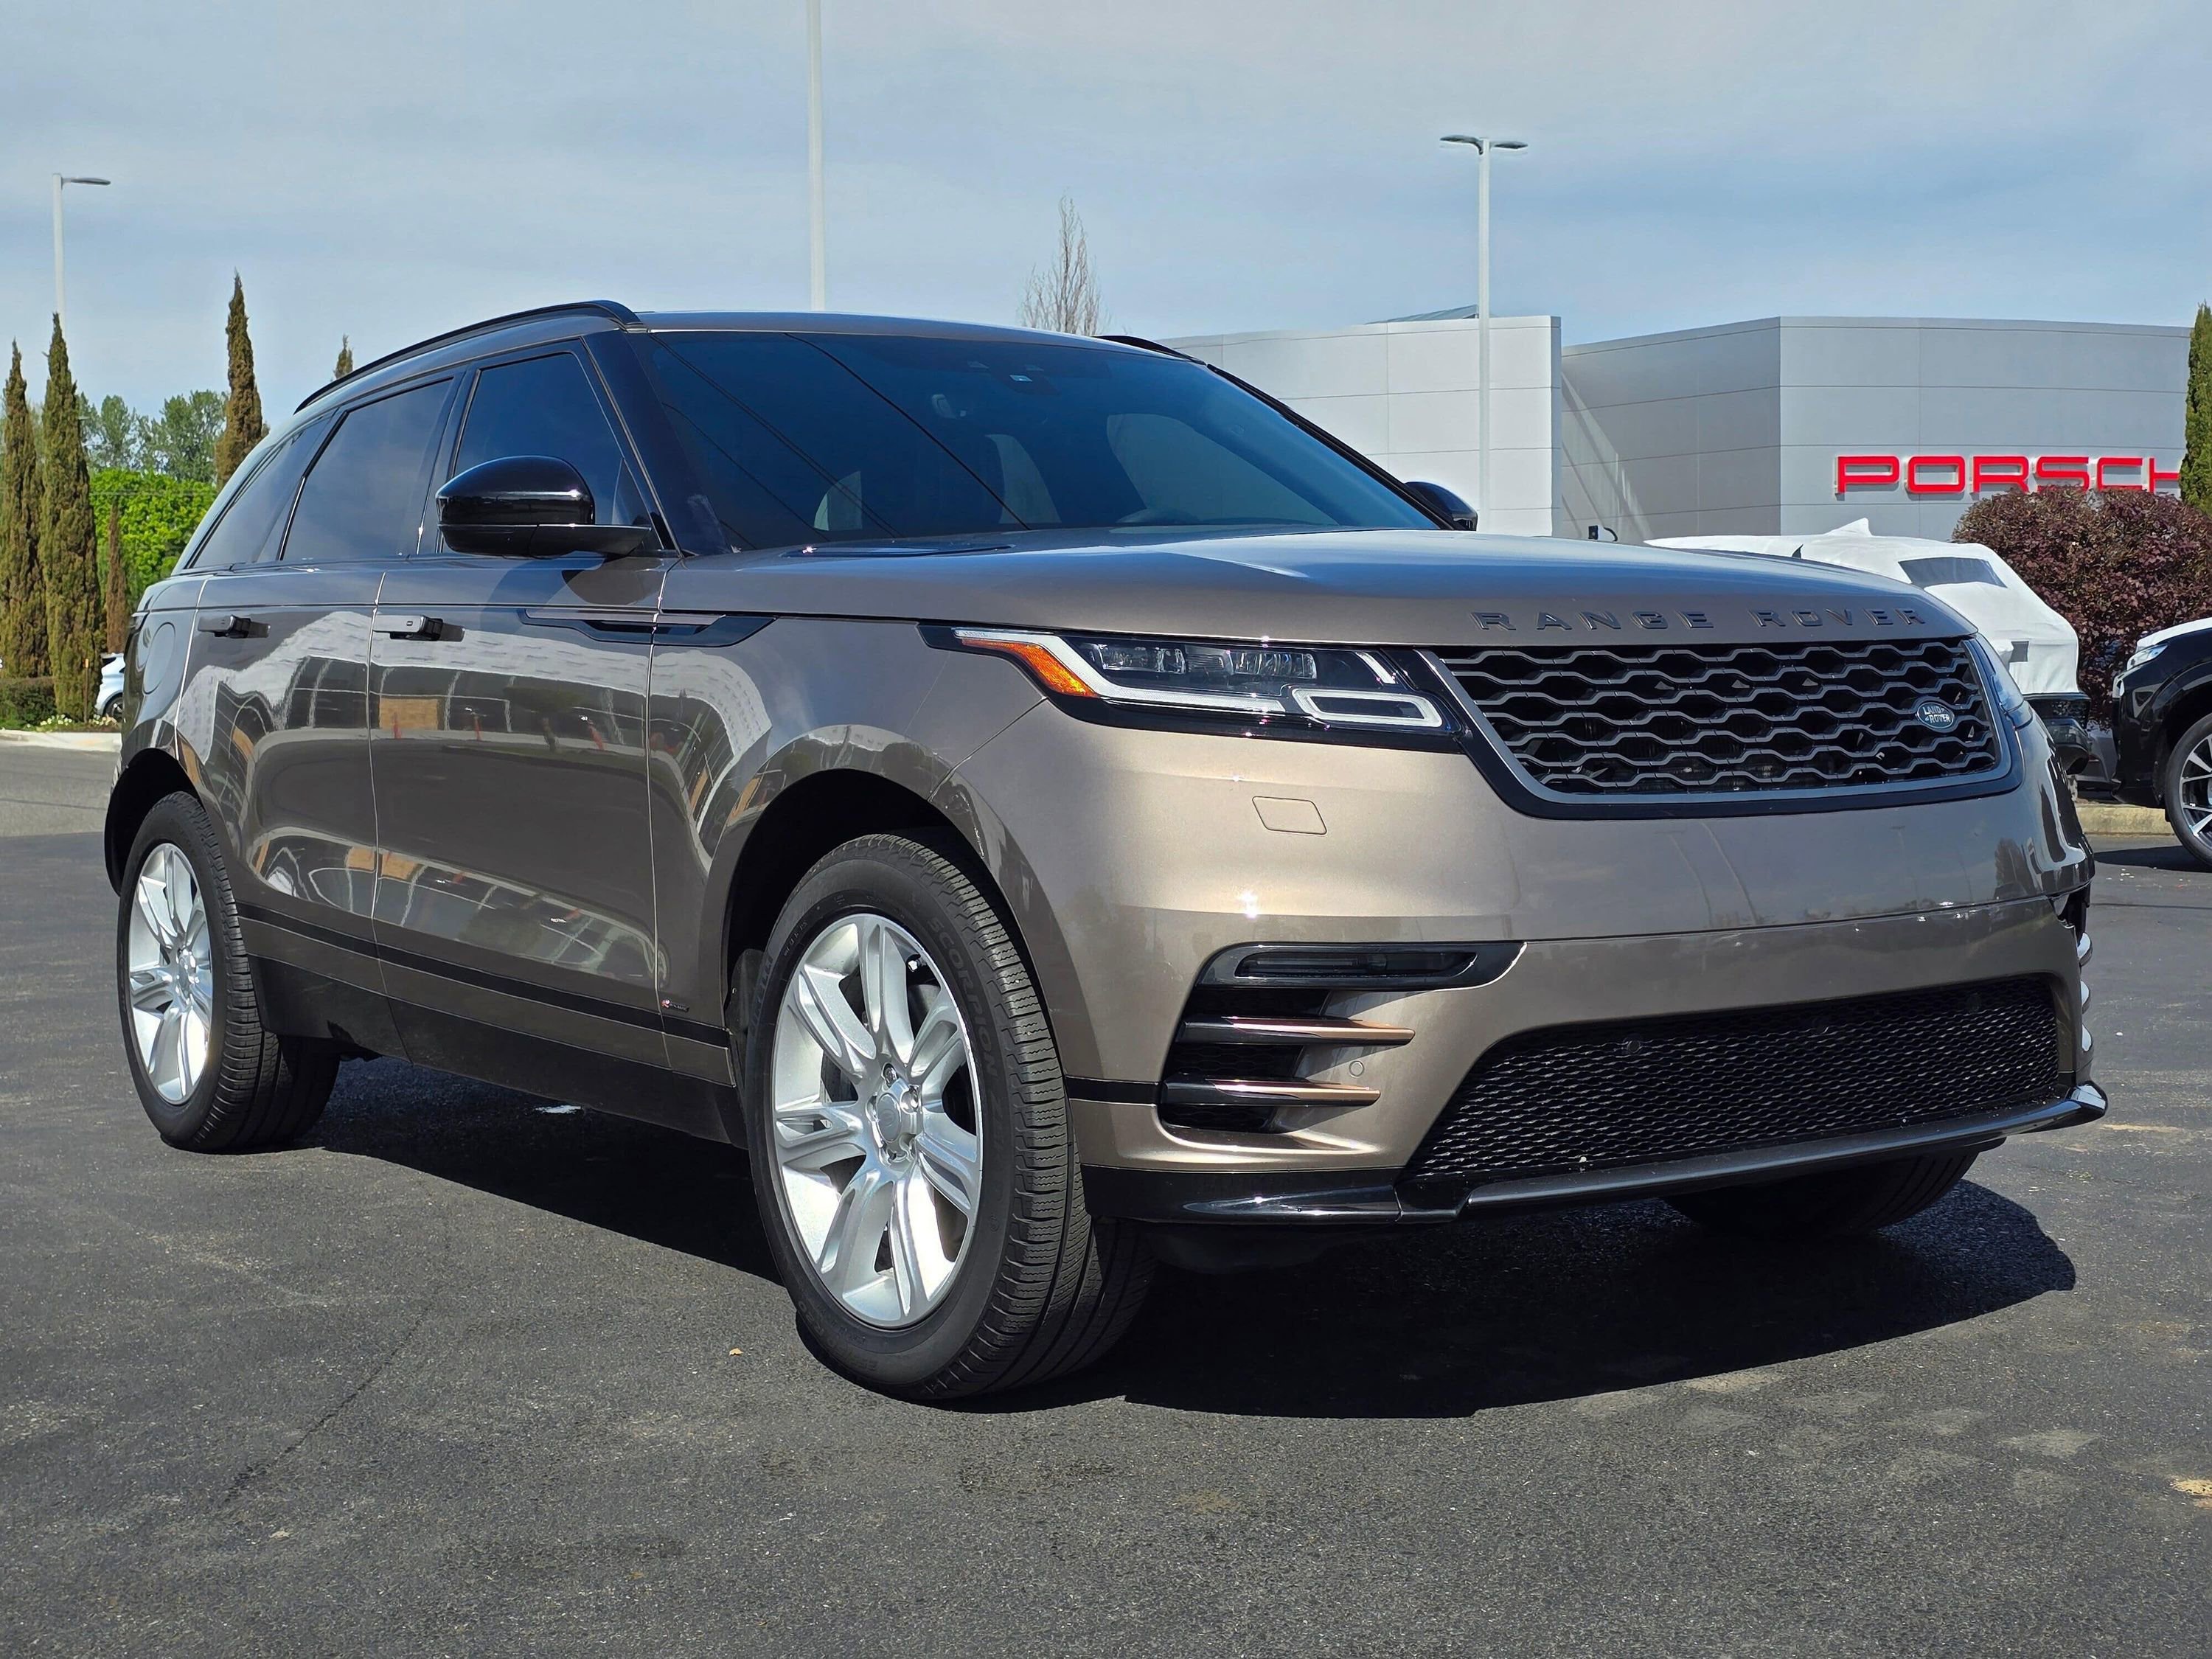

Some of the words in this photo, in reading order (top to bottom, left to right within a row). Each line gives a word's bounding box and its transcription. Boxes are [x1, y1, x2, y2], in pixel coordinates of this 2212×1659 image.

[1837, 456, 2180, 494] PORSCH
[1469, 611, 1714, 631] RANGE
[1749, 608, 1927, 627] ROVER
[1922, 706, 1941, 715] LAND
[1929, 713, 1951, 723] ROVER
[927, 917, 998, 1079] SCORPION
